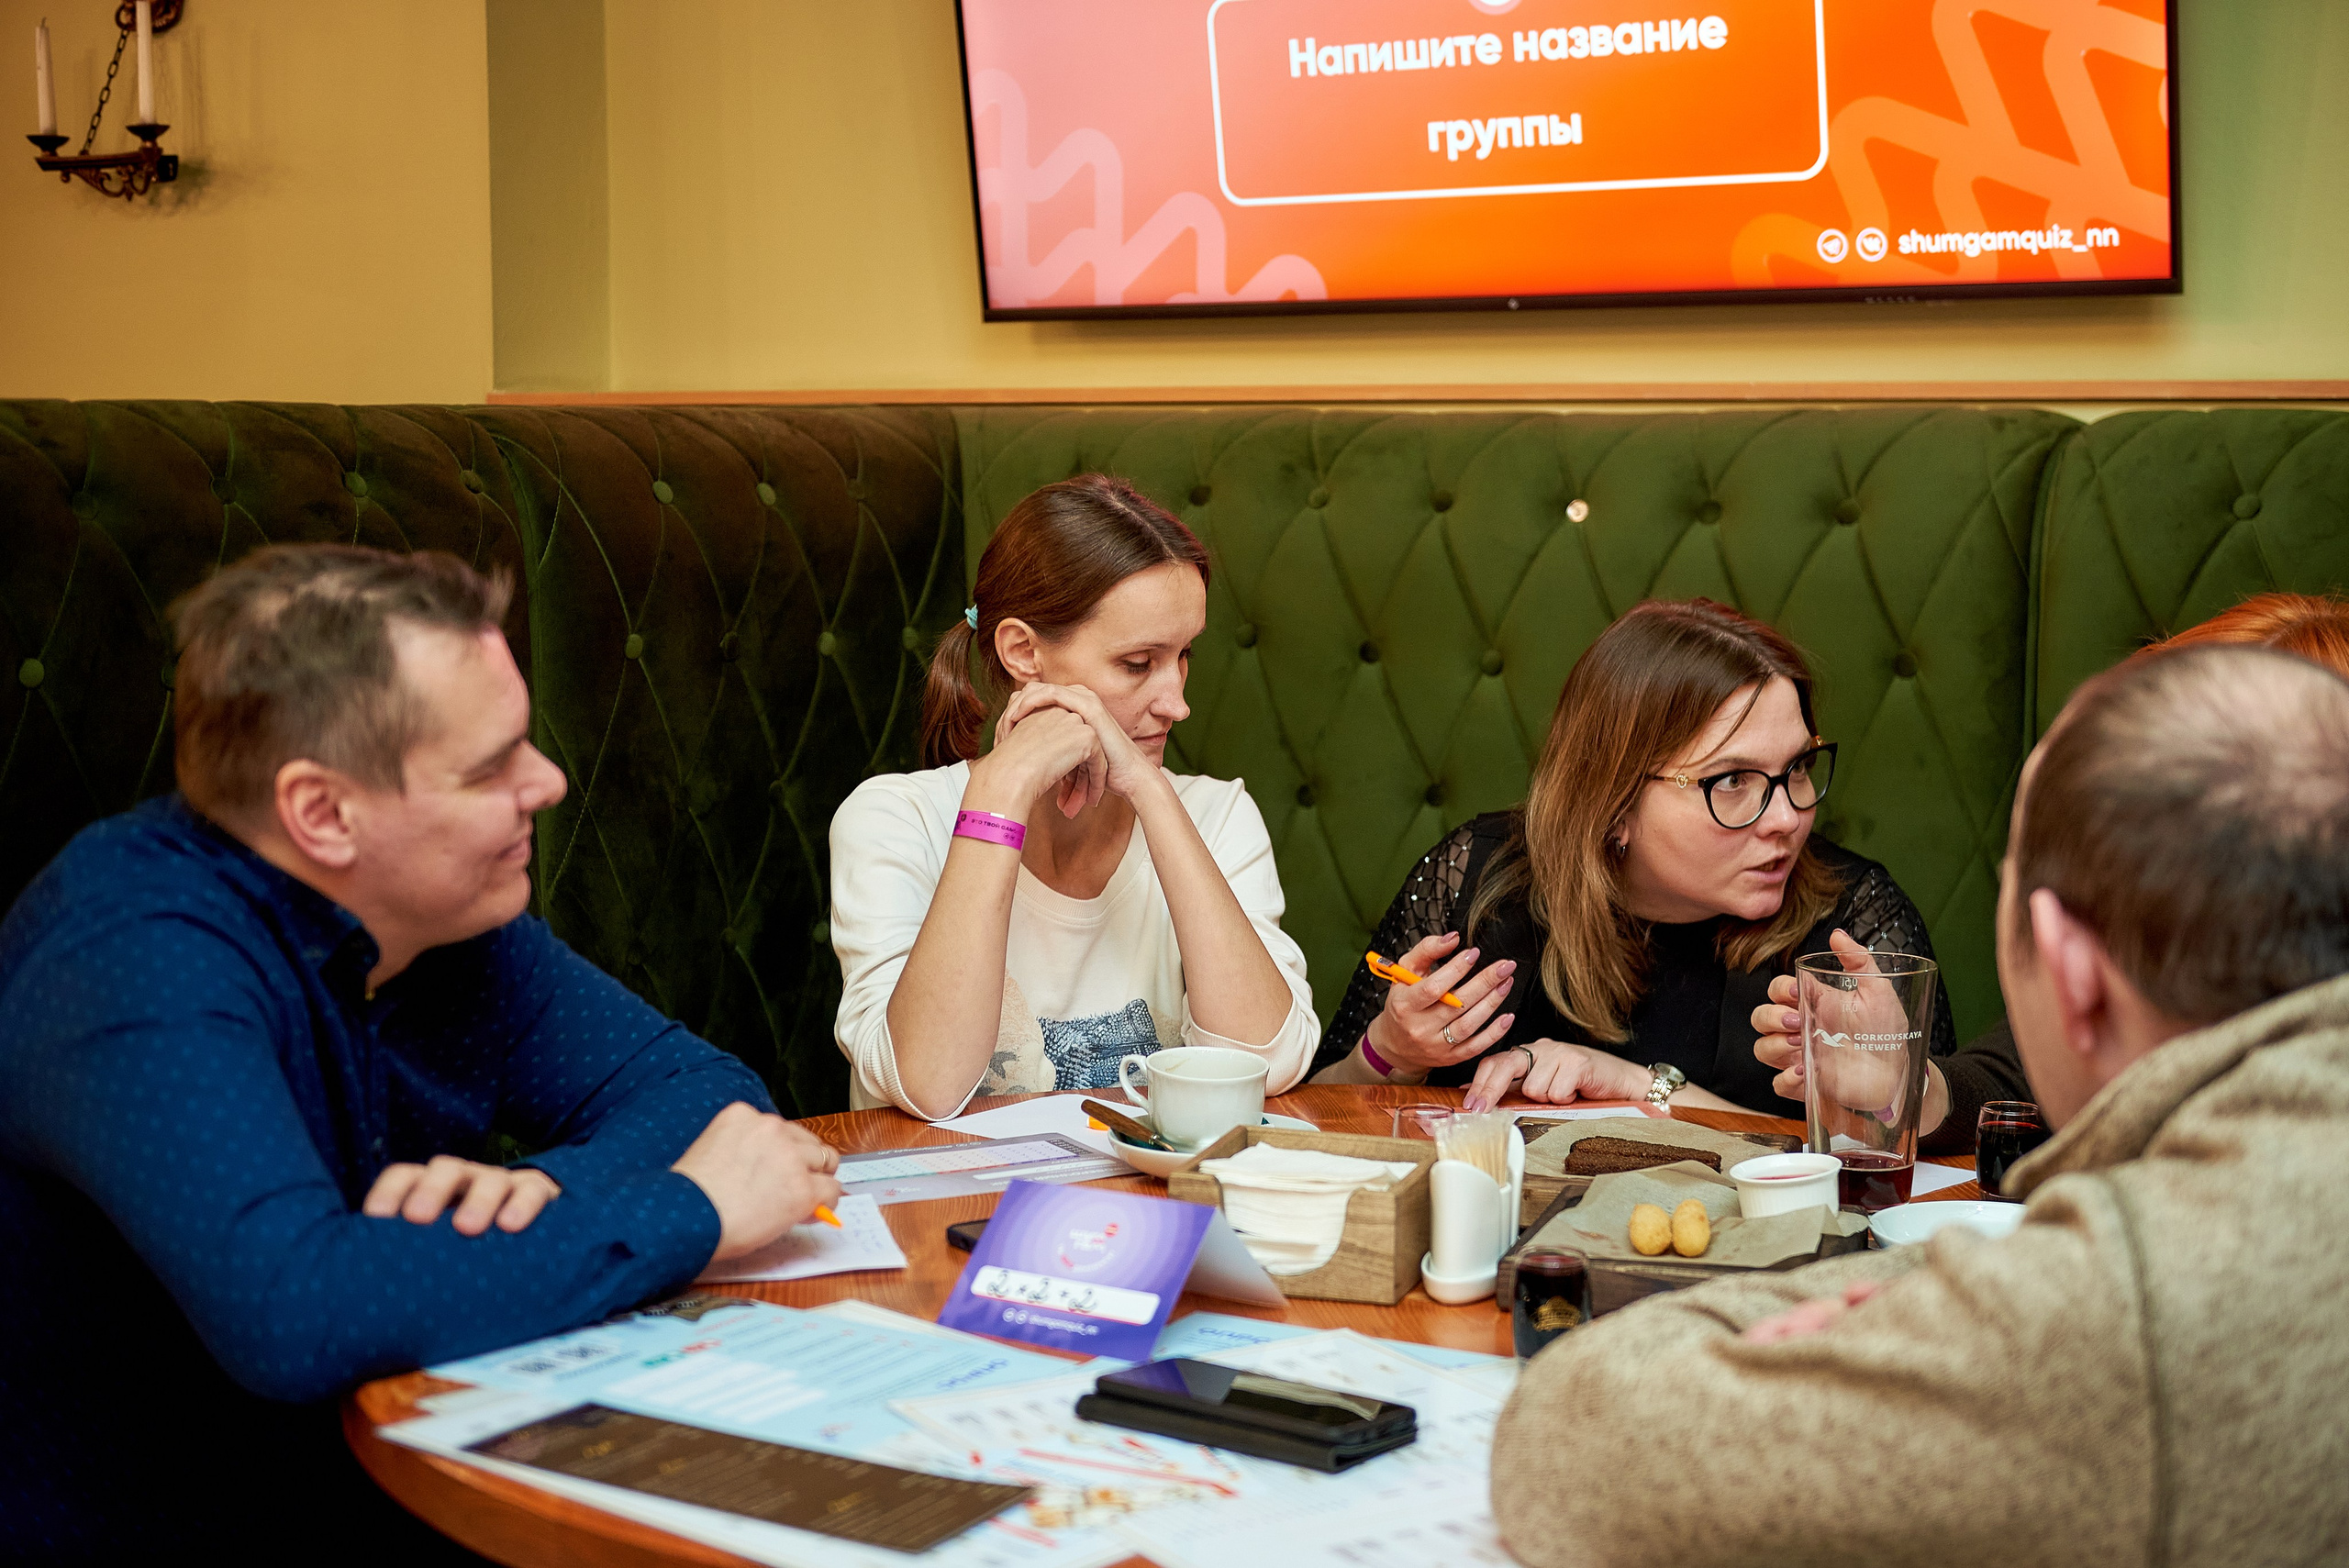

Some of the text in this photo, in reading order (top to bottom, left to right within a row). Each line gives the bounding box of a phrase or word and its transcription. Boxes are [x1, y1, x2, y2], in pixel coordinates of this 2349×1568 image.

[1288, 16, 1729, 78] Напишите название
[1428, 113, 1584, 161] группы
[1898, 224, 2119, 258] shumgamquiz_nn
[1854, 1030, 1922, 1041] GORKOVSKAYA
[1854, 1043, 1902, 1051] BREWERY
